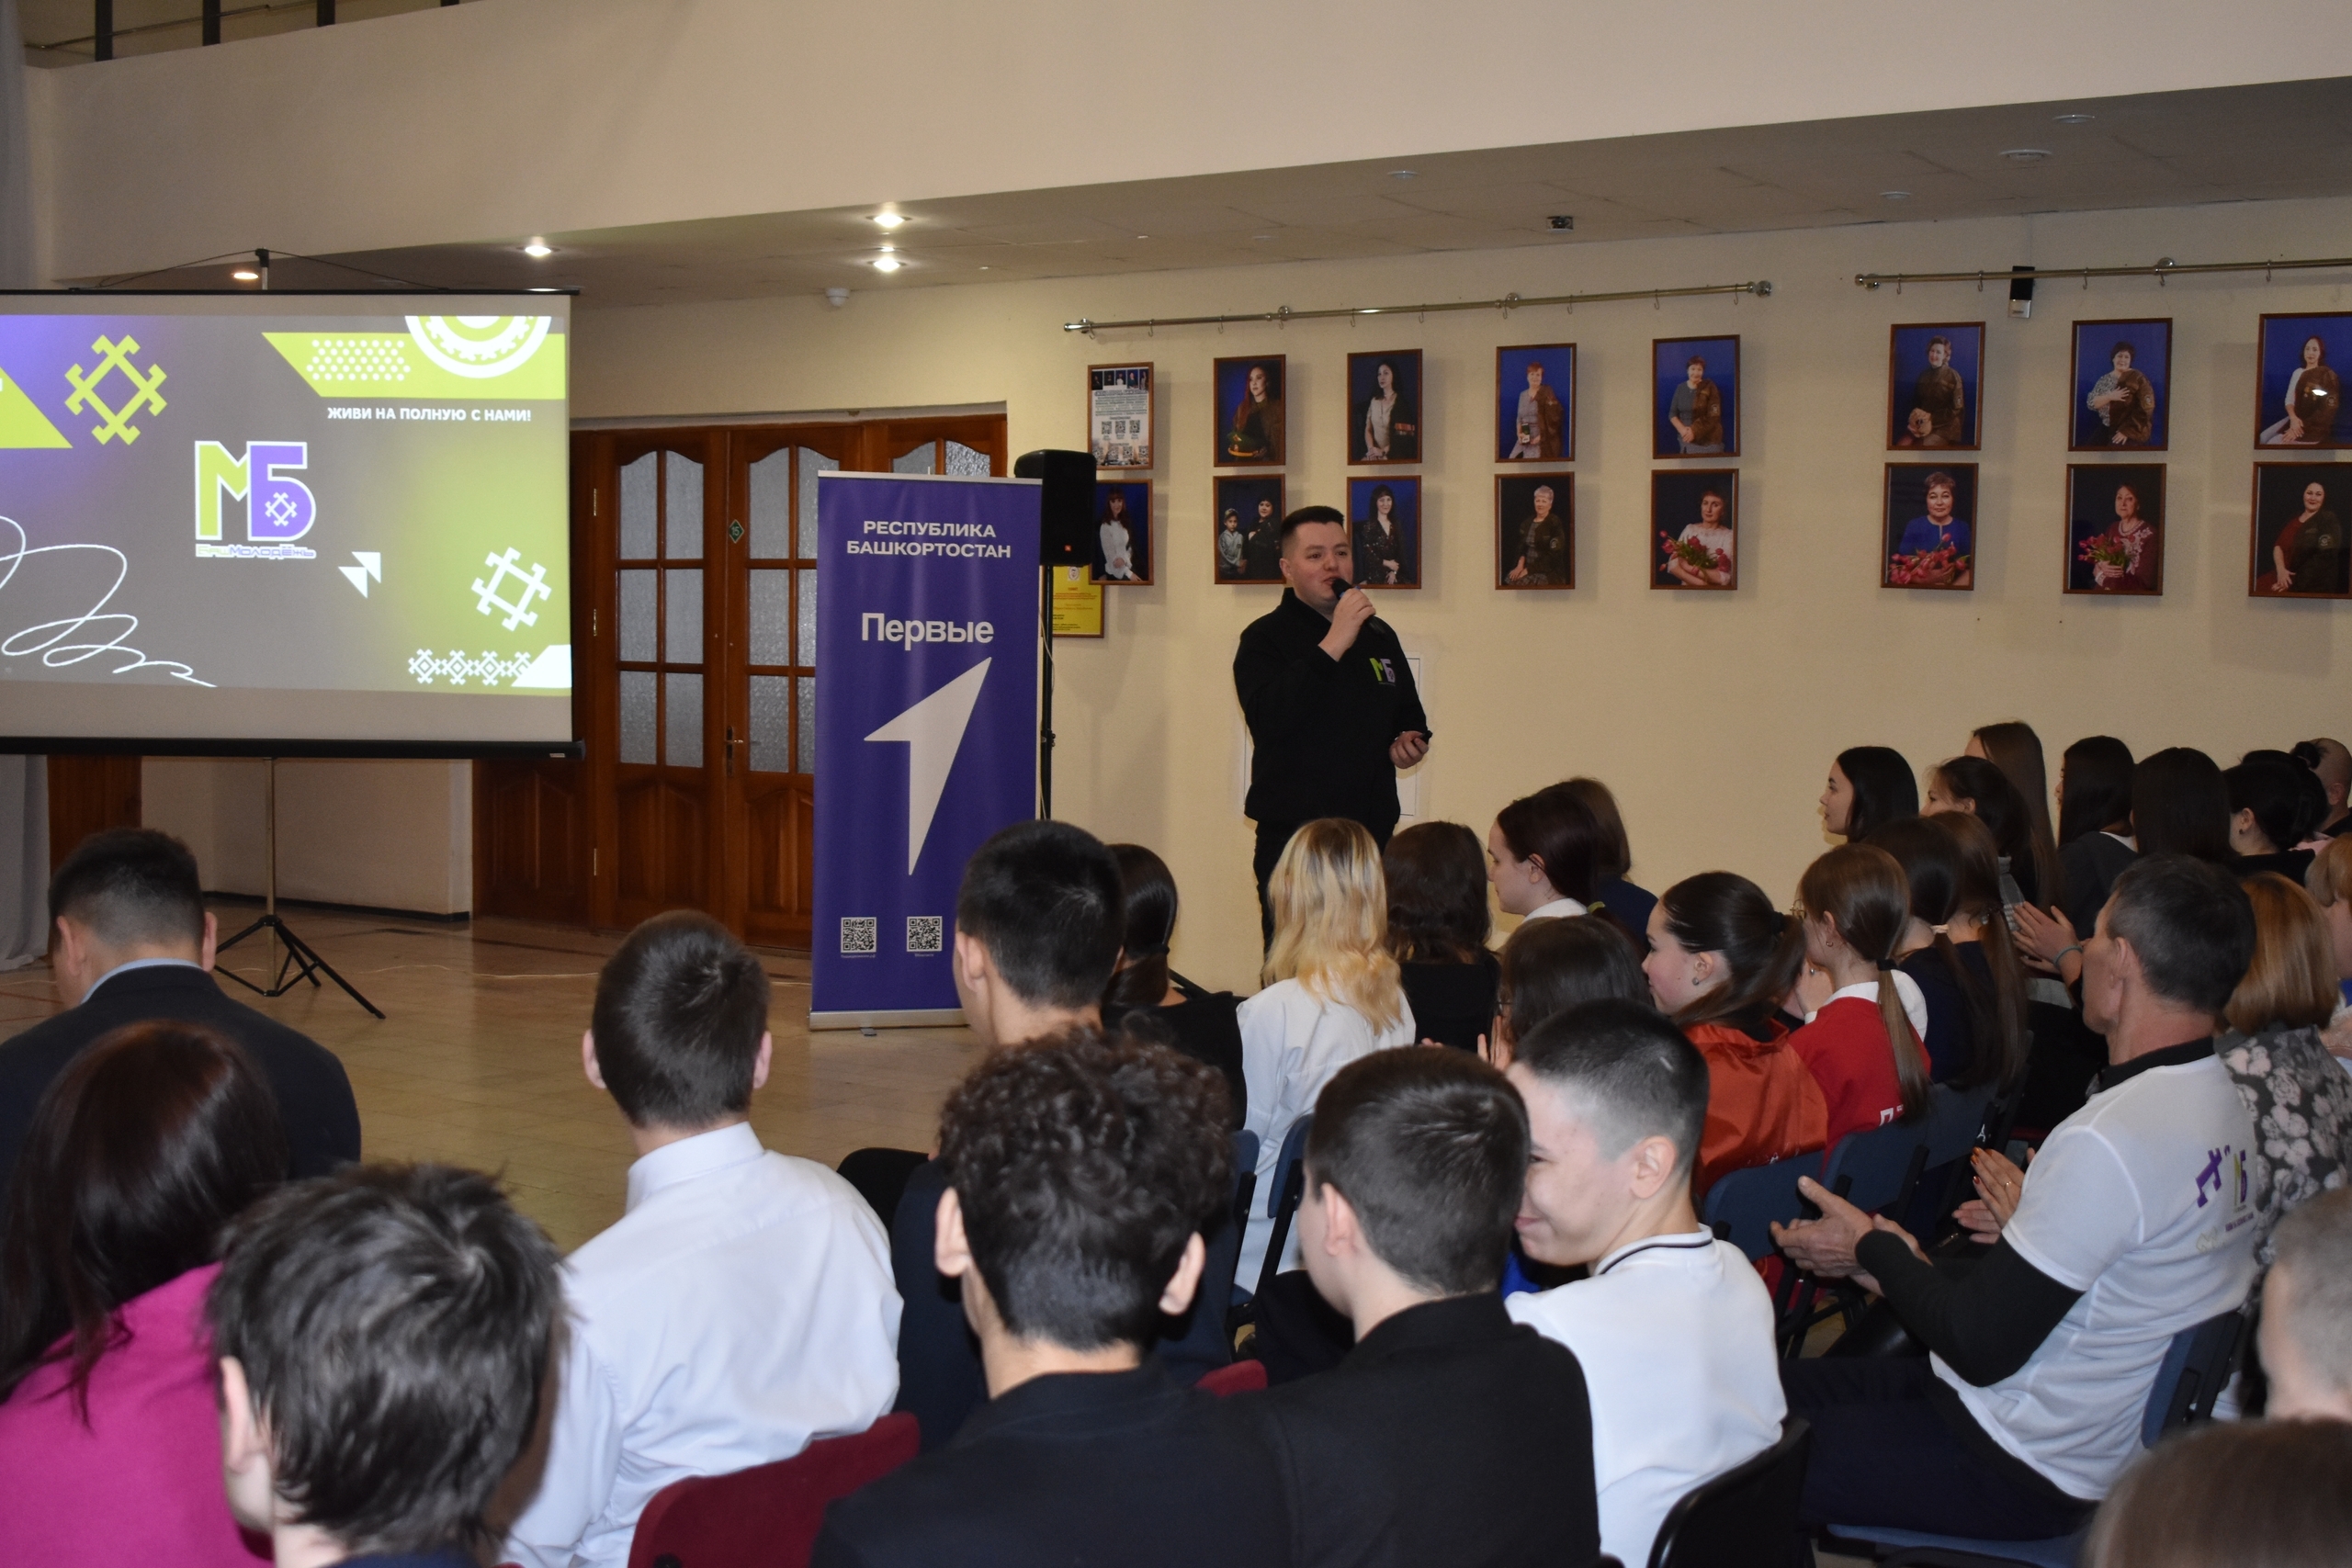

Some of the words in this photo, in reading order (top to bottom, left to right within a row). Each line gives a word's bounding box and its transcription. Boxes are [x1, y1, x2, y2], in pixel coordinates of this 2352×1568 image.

[327, 407, 372, 420] ЖИВИ
[376, 407, 396, 420] НА
[400, 407, 467, 421] ПОЛНУЮ
[470, 409, 481, 421] С
[484, 409, 532, 422] НАМИ!
[195, 441, 316, 541] МБ
[864, 520, 996, 537] РЕСПУБЛИКА
[846, 540, 1011, 558] БАШКОРТОСТАН
[862, 612, 994, 651] Первые
[1369, 658, 1396, 683] МБ
